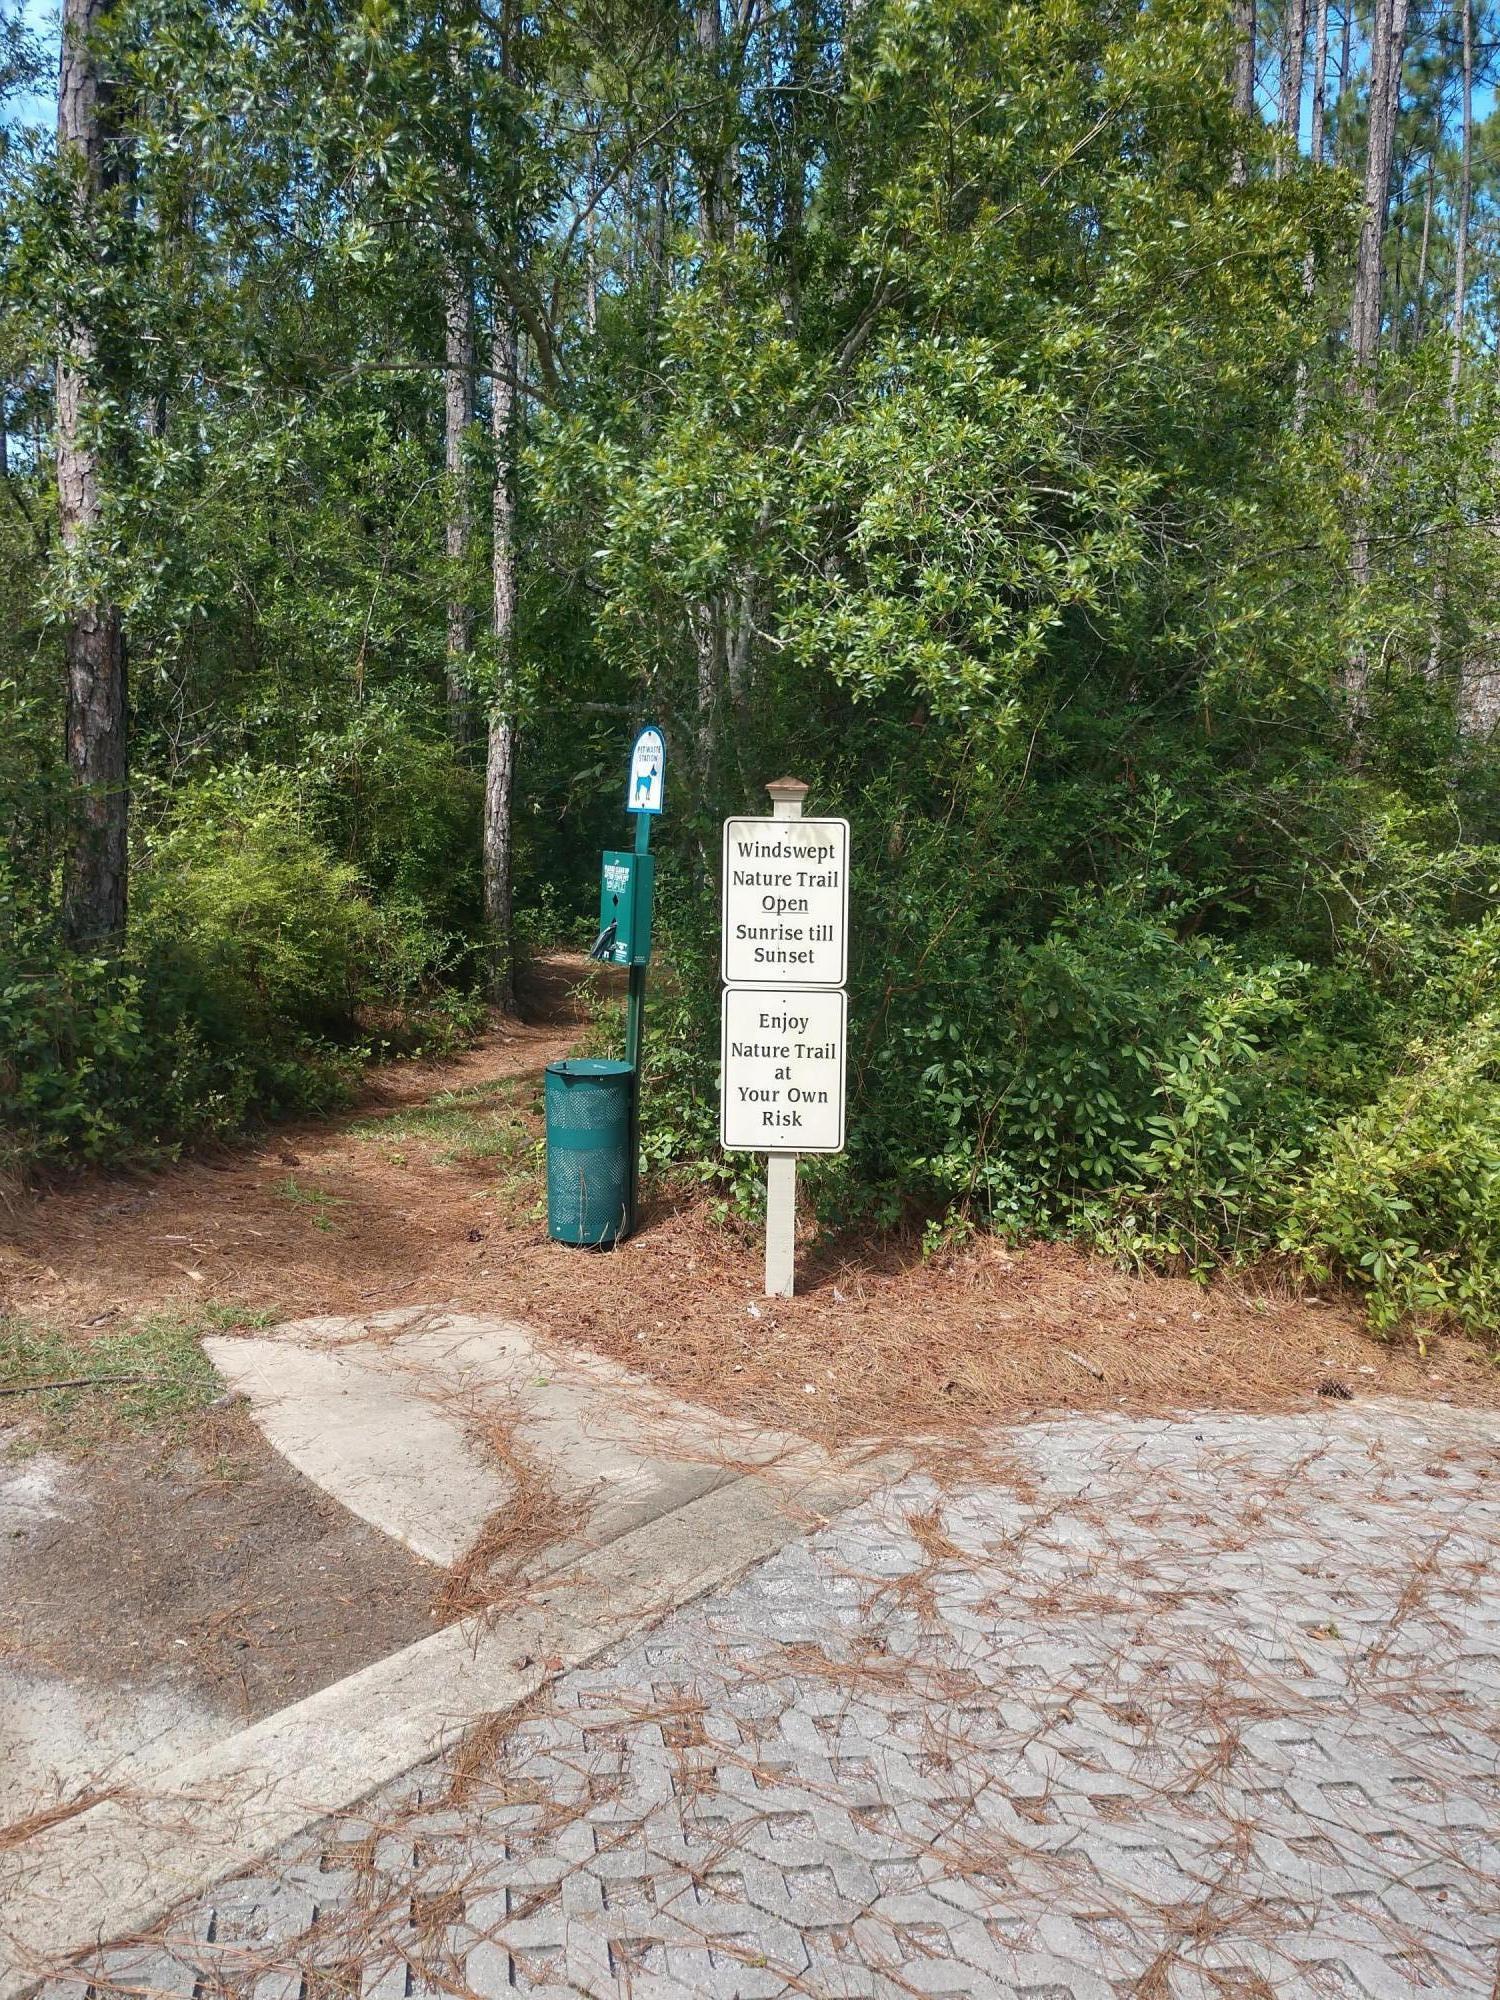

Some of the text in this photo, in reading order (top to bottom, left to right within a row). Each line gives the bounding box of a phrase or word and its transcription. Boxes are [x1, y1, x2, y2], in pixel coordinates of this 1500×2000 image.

[637, 745, 661, 754] PET WASTE
[638, 754, 659, 762] STATION
[737, 841, 835, 864] Windswept
[733, 871, 838, 887] Nature Trail
[762, 895, 808, 915] Open
[736, 924, 833, 941] Sunrise till
[754, 947, 814, 963] Sunset
[759, 1013, 809, 1034] Enjoy
[731, 1043, 836, 1059] Nature Trail
[774, 1066, 792, 1080] at
[738, 1086, 828, 1103] Your Own
[762, 1110, 803, 1126] Risk
